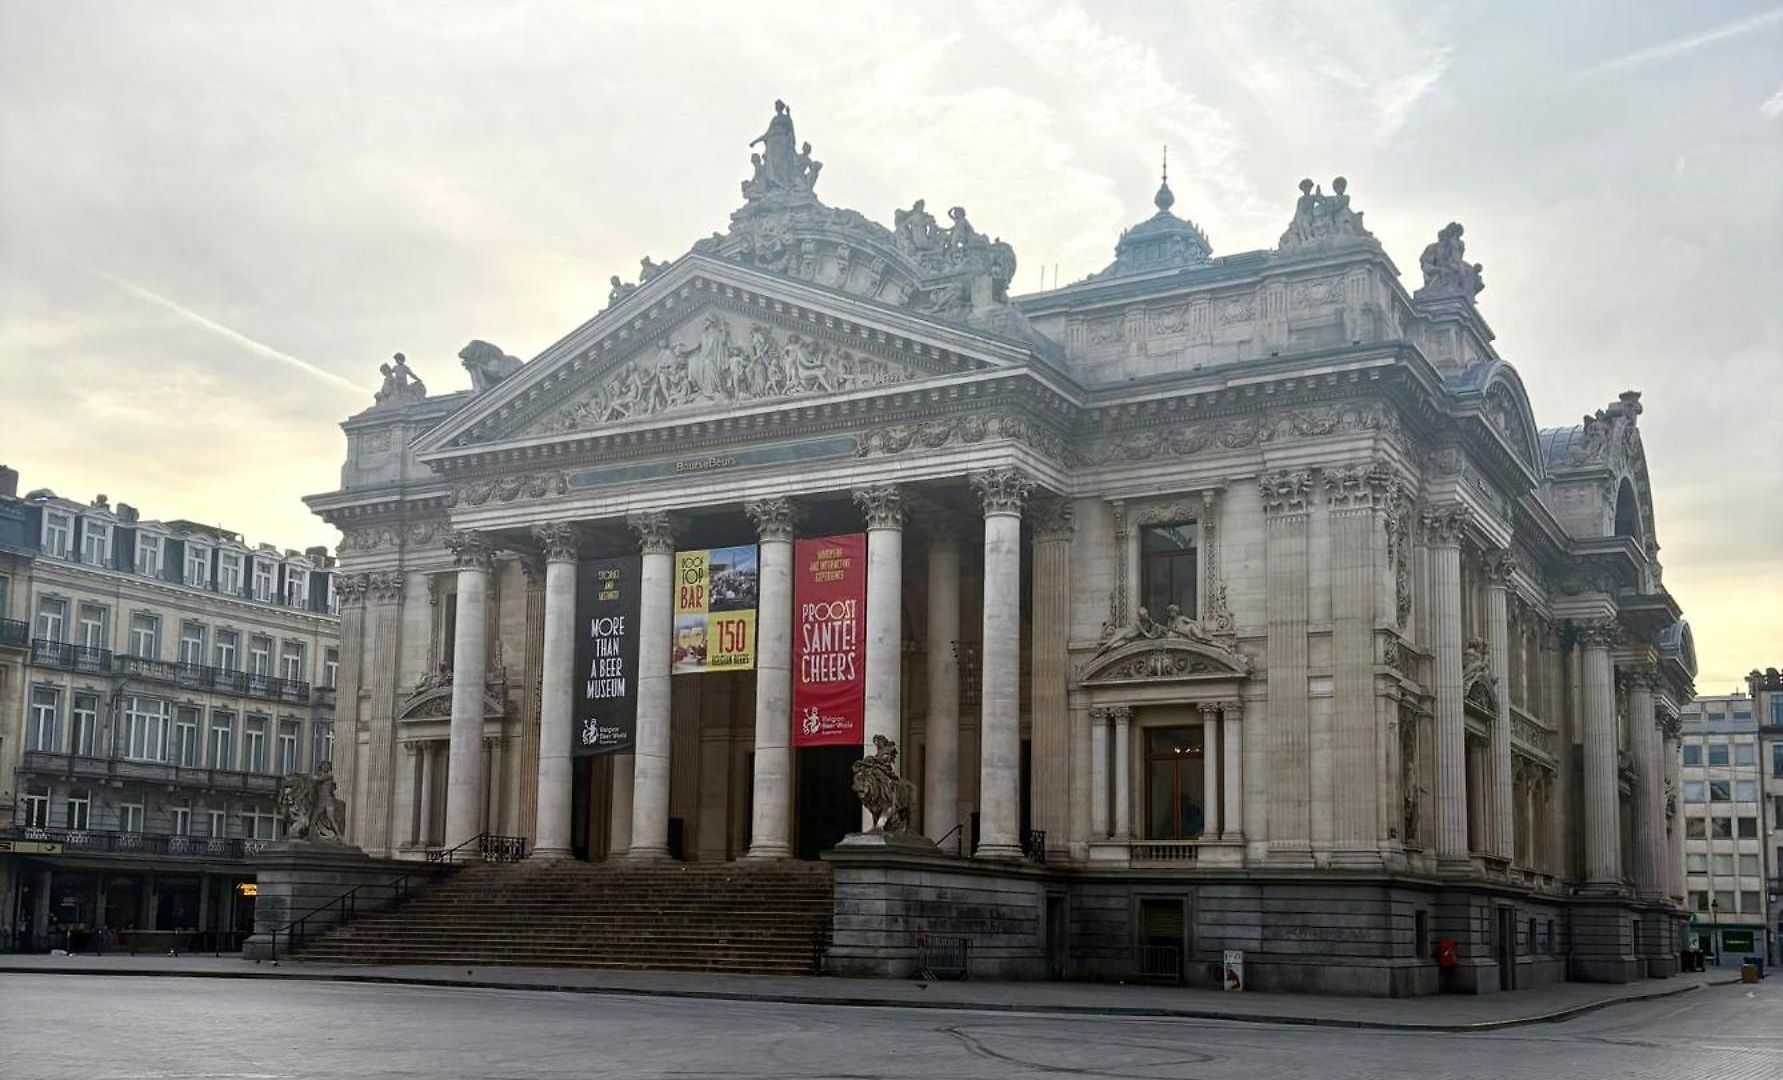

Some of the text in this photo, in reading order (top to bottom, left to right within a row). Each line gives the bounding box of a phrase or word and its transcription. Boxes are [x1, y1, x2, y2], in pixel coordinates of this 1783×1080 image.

[682, 568, 703, 584] TOP
[681, 585, 703, 608] BAR
[802, 599, 857, 622] PROOST
[591, 616, 625, 637] MORE
[717, 619, 746, 653] 150
[595, 637, 620, 657] THAN
[590, 658, 622, 678] A BEER
[802, 651, 856, 684] CHEERS
[586, 677, 625, 699] MUSEUM
